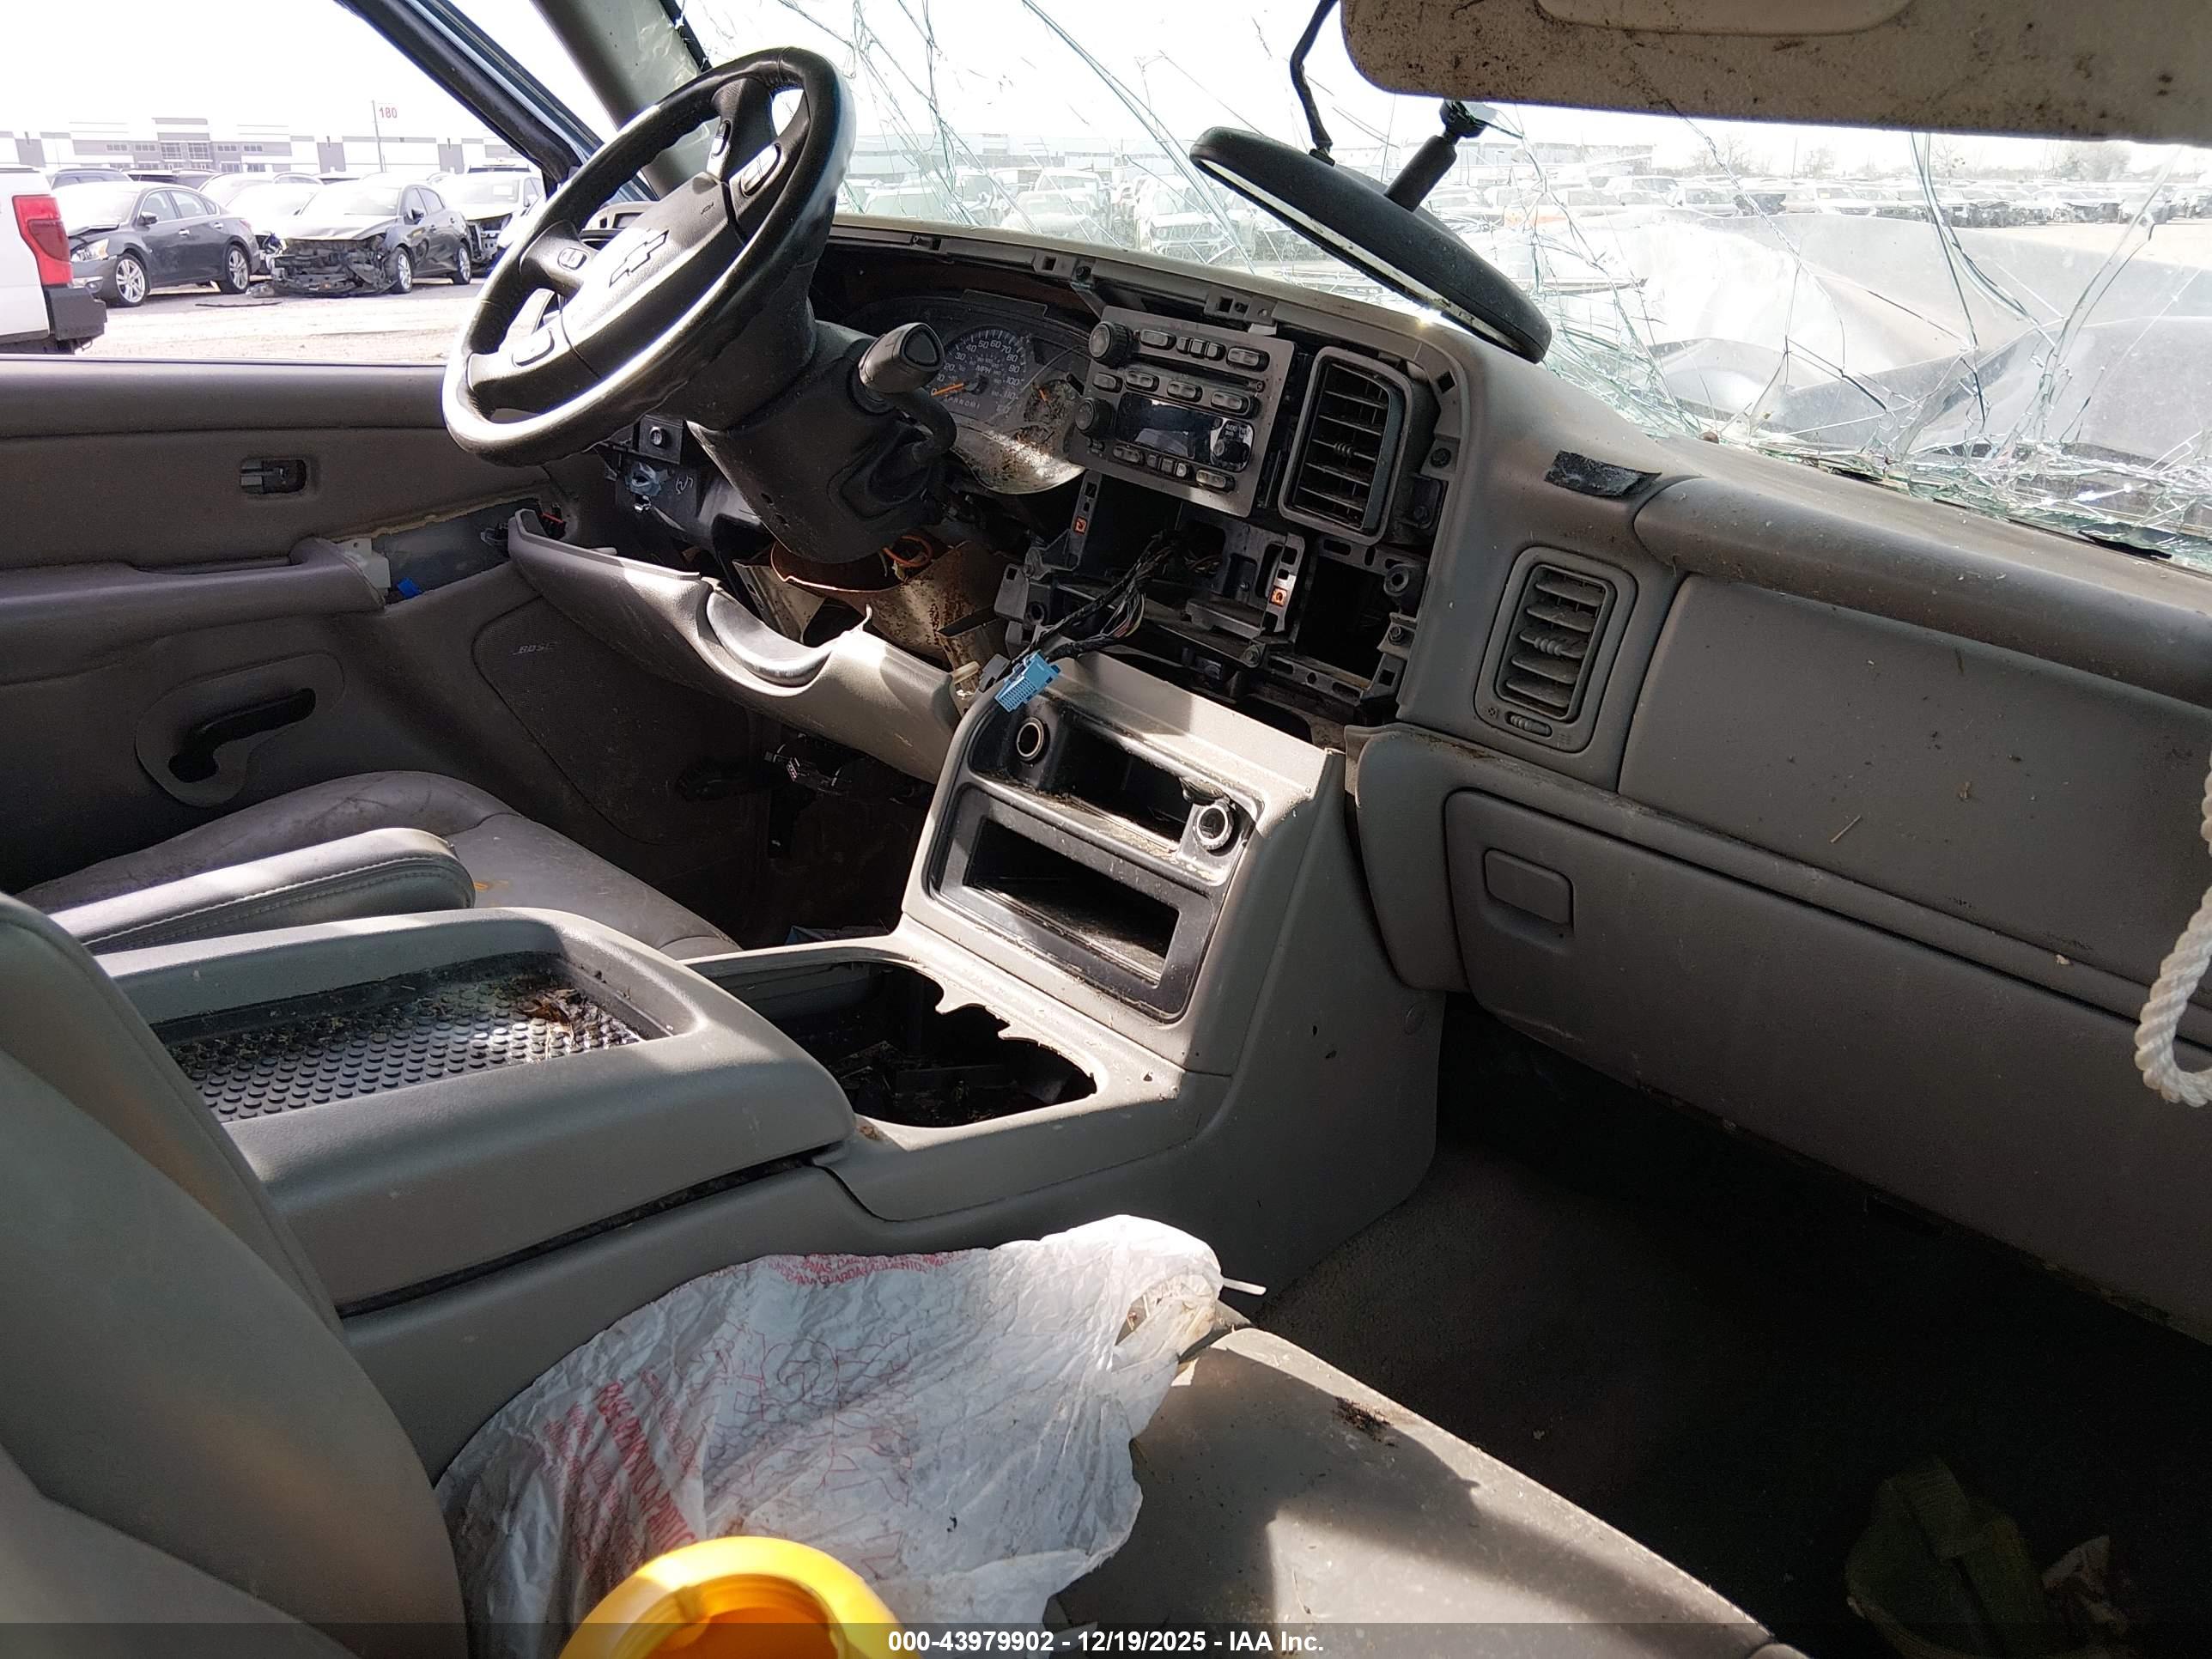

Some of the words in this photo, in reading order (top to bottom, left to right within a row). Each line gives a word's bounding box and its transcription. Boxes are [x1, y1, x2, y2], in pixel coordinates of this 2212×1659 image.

[380, 106, 398, 118] 180
[990, 340, 1001, 349] 60
[1001, 344, 1012, 354] 70
[955, 352, 966, 361] 30
[1006, 353, 1018, 362] 80
[944, 363, 955, 372] 20
[975, 365, 992, 374] MPH
[1006, 377, 1019, 386] 100
